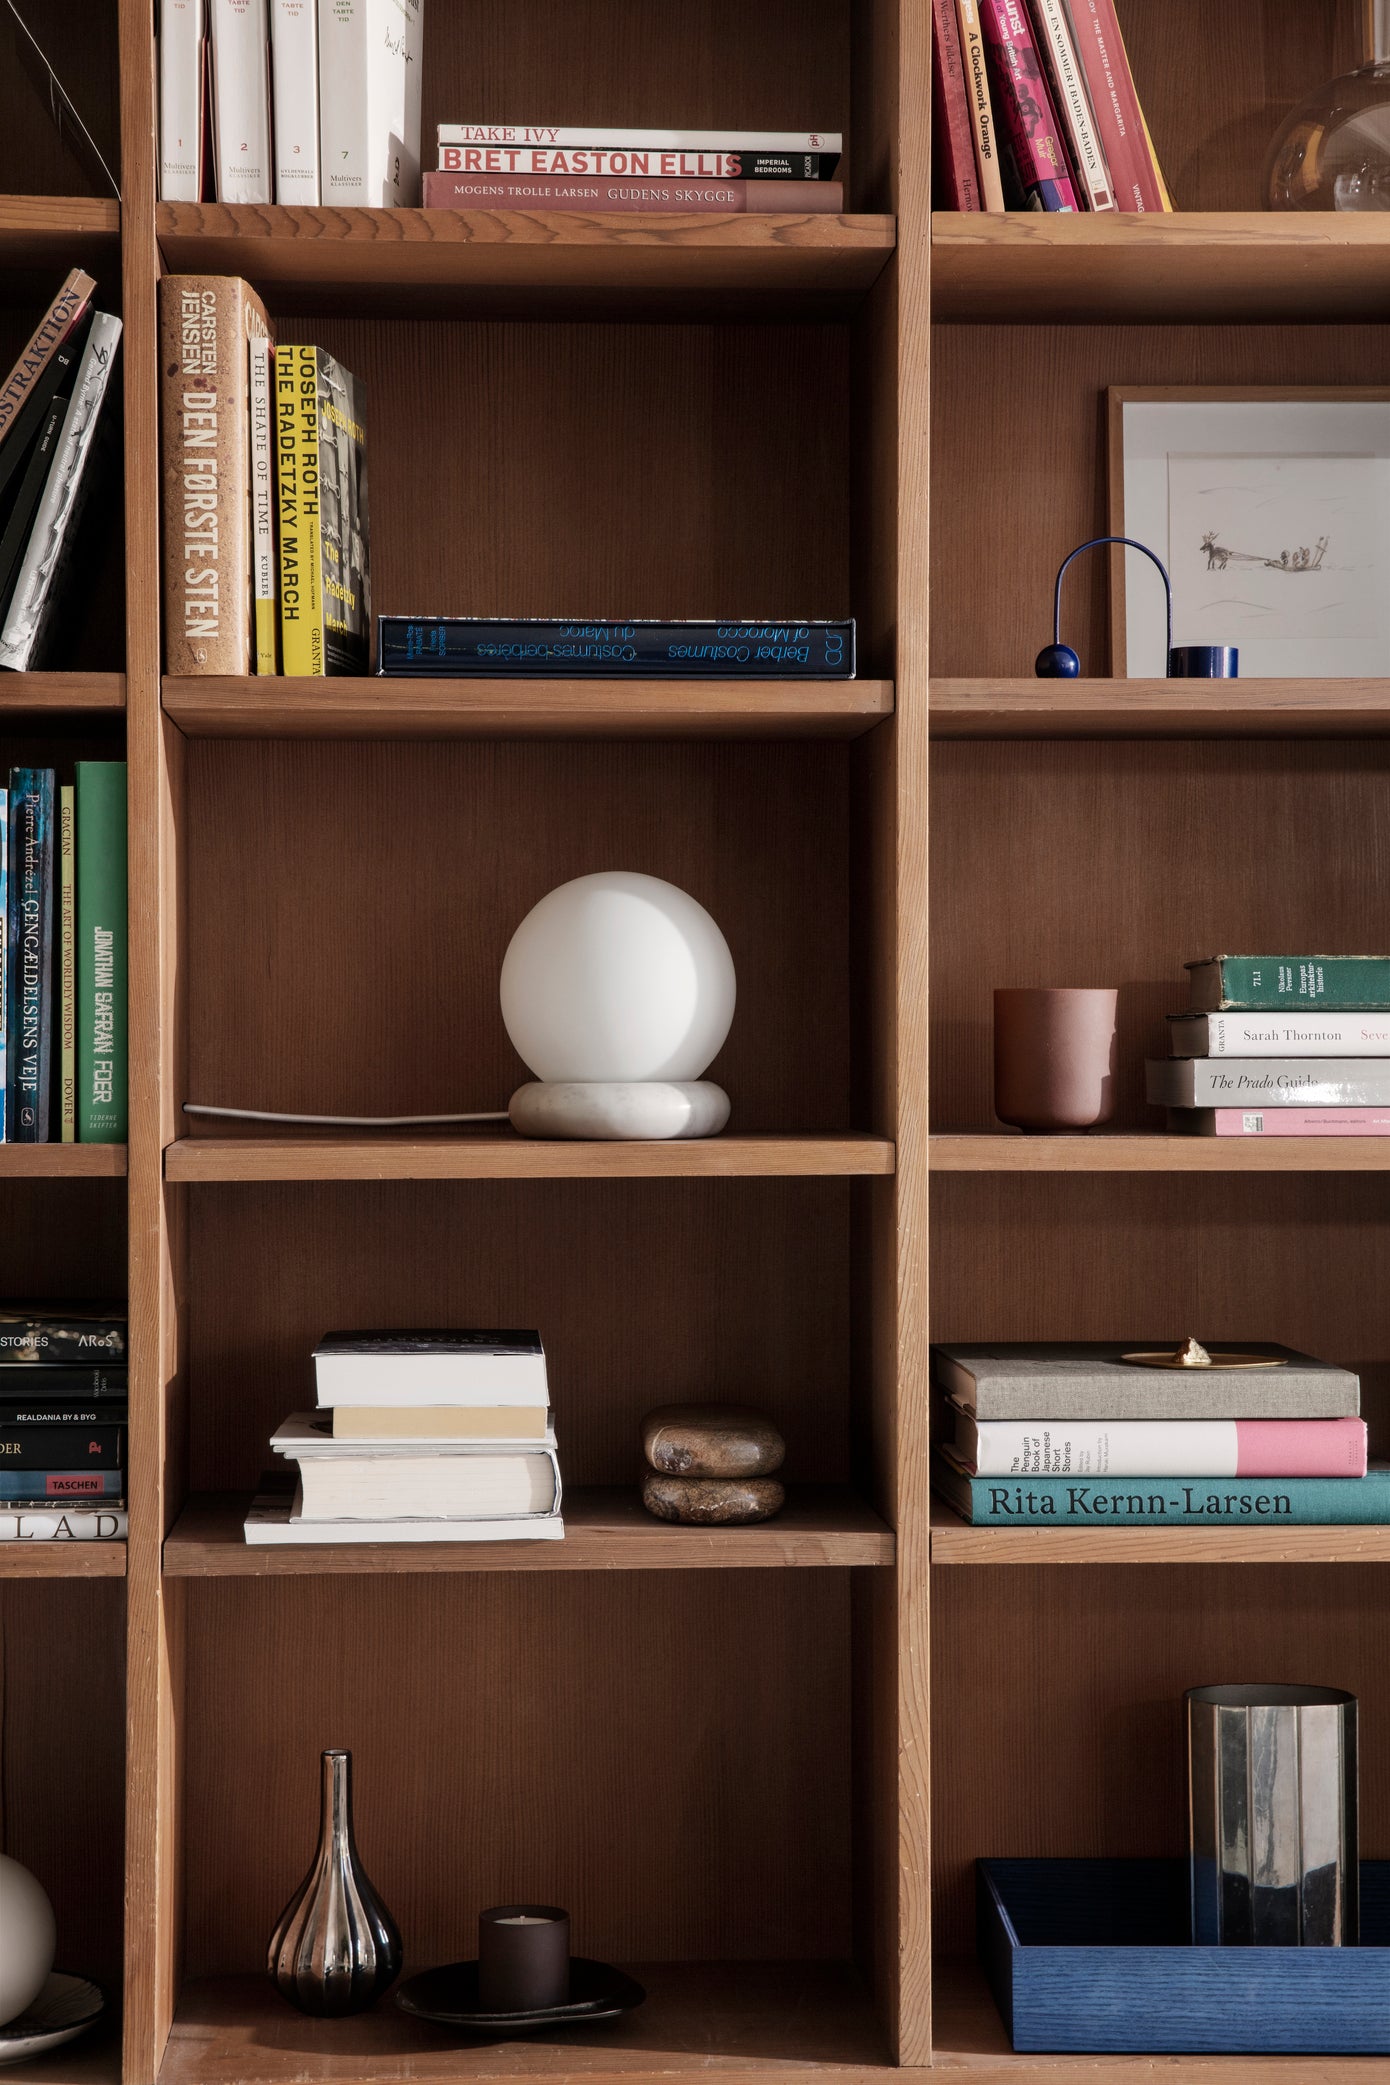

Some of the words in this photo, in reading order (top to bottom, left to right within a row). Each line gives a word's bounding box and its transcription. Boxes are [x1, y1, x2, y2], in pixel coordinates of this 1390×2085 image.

[968, 32, 979, 42] A
[1051, 17, 1060, 32] EN
[1000, 14, 1010, 40] Young
[1006, 40, 1018, 67] British
[1013, 67, 1023, 80] Art
[1055, 34, 1074, 82] SOMMER
[970, 46, 987, 111] Clockwork
[1093, 18, 1101, 35] THE
[1097, 36, 1109, 69] MASTER
[1105, 71, 1114, 89] AND
[1110, 90, 1126, 137] MARGARITA
[461, 126, 516, 141] TAKE
[523, 128, 560, 142] IVY
[980, 114, 992, 159] Orange
[1070, 90, 1097, 169] BADEN-BADEN
[241, 143, 248, 151] 2
[341, 151, 349, 159] 7
[1035, 138, 1047, 159] Muir
[1045, 136, 1059, 167] Gregor
[163, 162, 196, 170] Multivers
[444, 148, 521, 172] BRET
[531, 150, 649, 175] EASTON
[660, 153, 743, 177] ELLIS
[804, 155, 812, 178] PICADOR
[454, 185, 504, 195] MOGENS
[507, 187, 551, 196] TROLLE
[555, 188, 599, 198] LARSEN
[607, 188, 670, 200] GUDENS
[675, 189, 735, 202] SKYGGE
[181, 290, 201, 375] JENSEN
[201, 290, 217, 374] CARSTEN
[255, 353, 265, 387] THE
[277, 348, 295, 393] THE
[299, 348, 317, 443] JOSEPH
[47, 414, 58, 435] U-TURN
[183, 392, 218, 448] DEN
[255, 397, 267, 451] SHAPE
[321, 400, 347, 433] JOSEPH
[347, 418, 364, 446] ROTH
[256, 460, 268, 481] OF
[279, 403, 299, 529] RADETZKY
[302, 453, 319, 515] ROTH
[183, 458, 219, 560] FØRSTE
[257, 490, 269, 535] TIME
[325, 541, 339, 564] The
[261, 555, 269, 596] KUBLER
[282, 537, 300, 620] MARCH
[184, 567, 219, 638] STEN
[325, 575, 356, 611] Radetzky
[325, 612, 348, 637] March
[559, 626, 609, 641] Maroc
[614, 626, 636, 641] du
[717, 627, 790, 643] Morocco
[793, 627, 810, 643] of
[311, 628, 321, 675] GRANTA
[477, 643, 549, 660] berbères
[553, 644, 635, 661] Costumes
[668, 644, 750, 663] Costumes
[754, 645, 810, 663] Berber
[26, 794, 40, 833] Pierre
[62, 807, 71, 856] GRACIAN
[25, 834, 39, 894] Andrézel
[63, 884, 72, 906] THE
[63, 911, 72, 928] ART
[63, 931, 72, 947] OF
[94, 926, 114, 988] JONATHAN
[23, 899, 39, 1049] GENGÆLDELSENS
[63, 948, 72, 999] WORLDLY
[1253, 971, 1262, 987] 71.1
[1278, 966, 1286, 993] Nikolaus
[1299, 965, 1308, 994] Europas
[1308, 962, 1316, 998] arkitektur-
[1316, 966, 1324, 993] historie
[63, 1001, 73, 1050] WISDOM
[93, 991, 114, 1054] SAFRAN
[1243, 1029, 1279, 1041] Sarah
[1283, 1029, 1342, 1041] Thornton
[1360, 1030, 1389, 1040] Seve
[18, 1054, 37, 1091] VEJE
[92, 1060, 113, 1106] FOER
[1210, 1074, 1234, 1089] The
[1237, 1074, 1274, 1089] Prado
[64, 1078, 73, 1115] DOVER
[0, 1337, 49, 1347] STORIES
[80, 1413, 97, 1421] BYG
[1021, 1437, 1031, 1472] Penguin
[1032, 1438, 1040, 1448] of
[1042, 1431, 1051, 1472] Japanese
[1062, 1441, 1071, 1472] Stories
[1011, 1457, 1020, 1472] The
[1031, 1450, 1040, 1472] Book
[1052, 1449, 1061, 1472] Short
[52, 1481, 98, 1490] TASCHEN
[988, 1488, 1057, 1515] Rita
[1066, 1488, 1293, 1515] Kernn-Larsen
